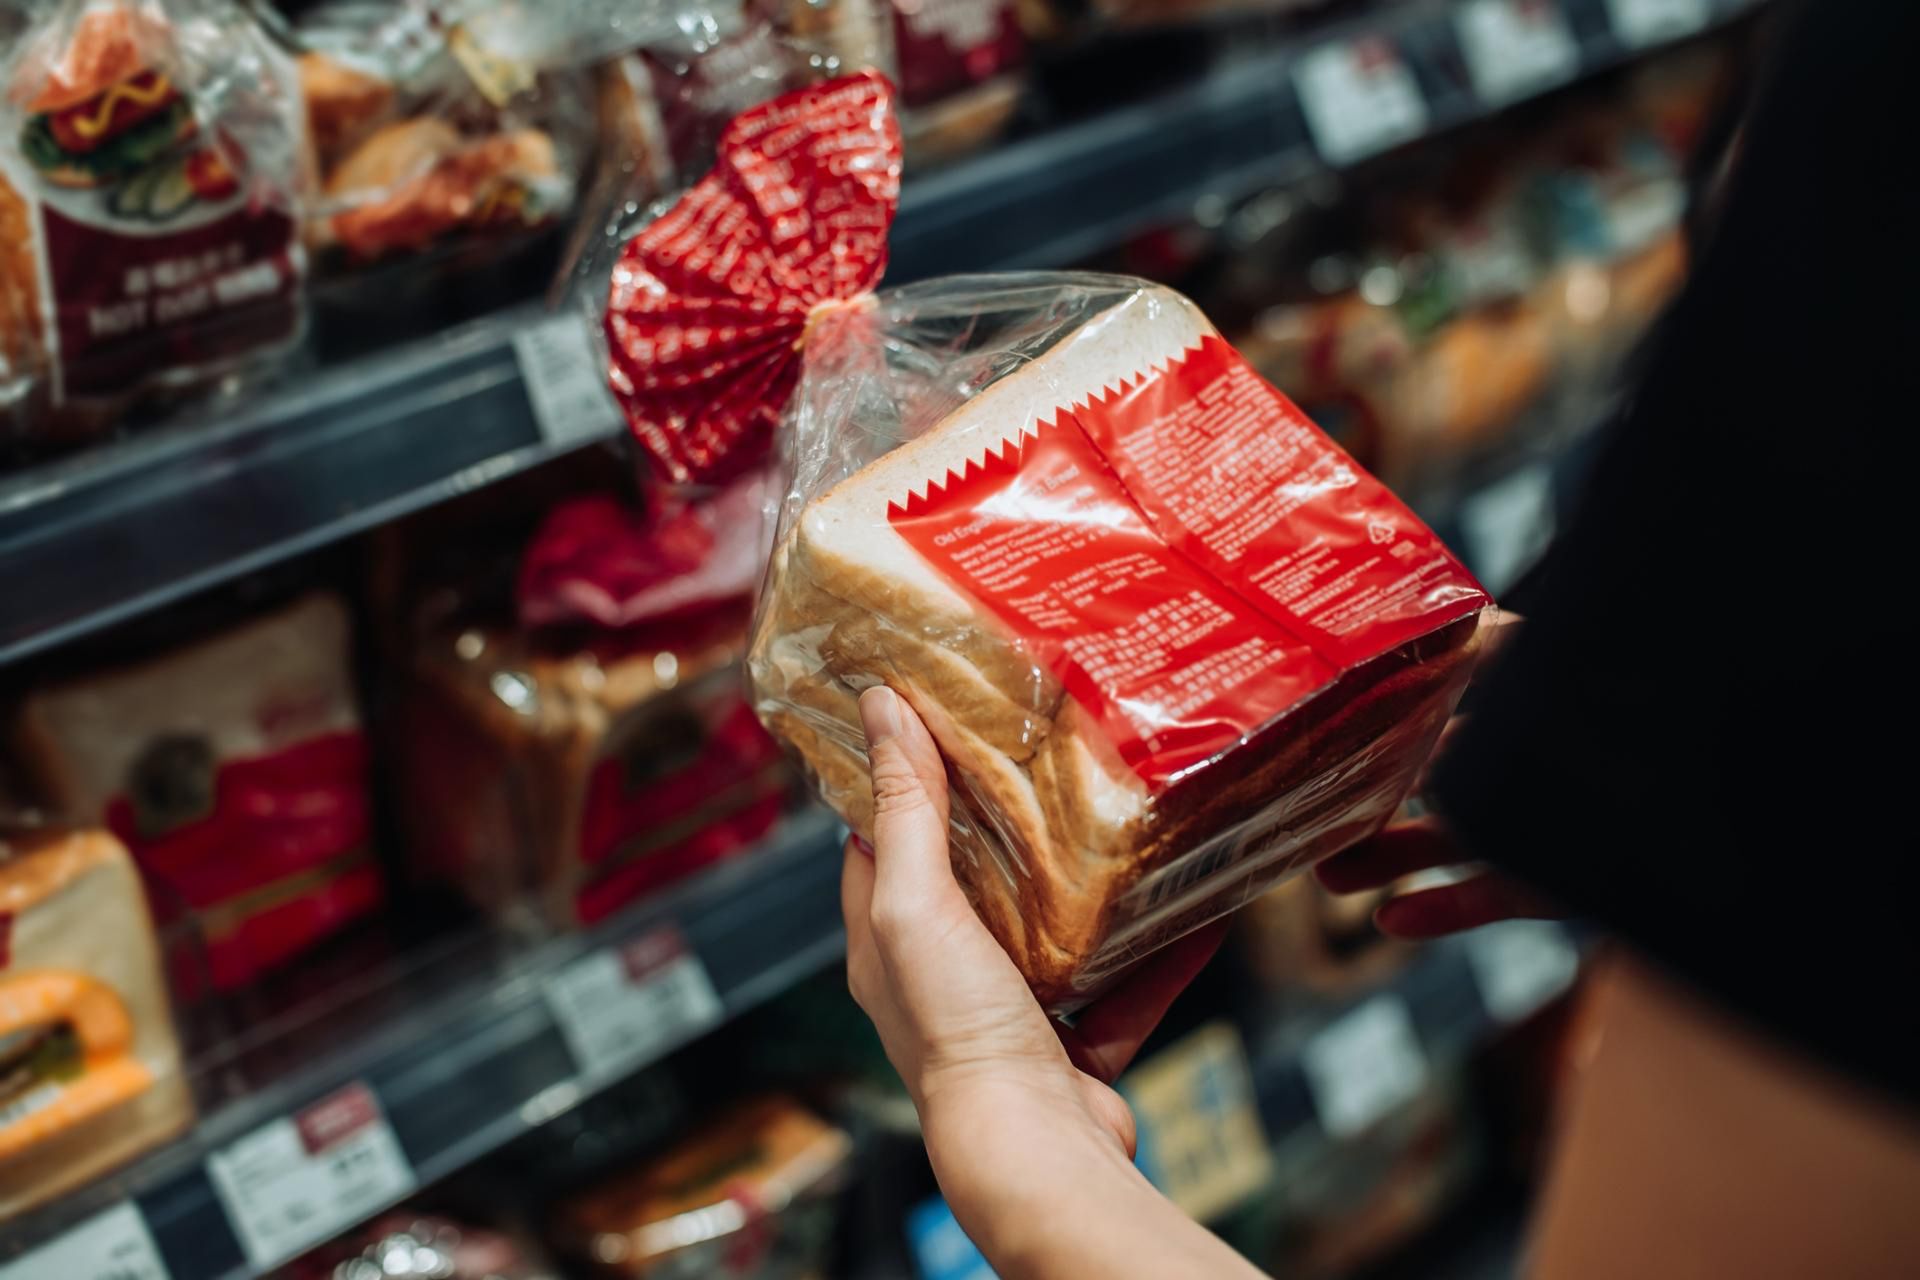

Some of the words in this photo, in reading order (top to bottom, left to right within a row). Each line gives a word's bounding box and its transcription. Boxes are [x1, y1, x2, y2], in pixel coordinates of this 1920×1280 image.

[931, 529, 957, 549] Old
[1043, 462, 1081, 491] Bread
[1048, 577, 1069, 593] To
